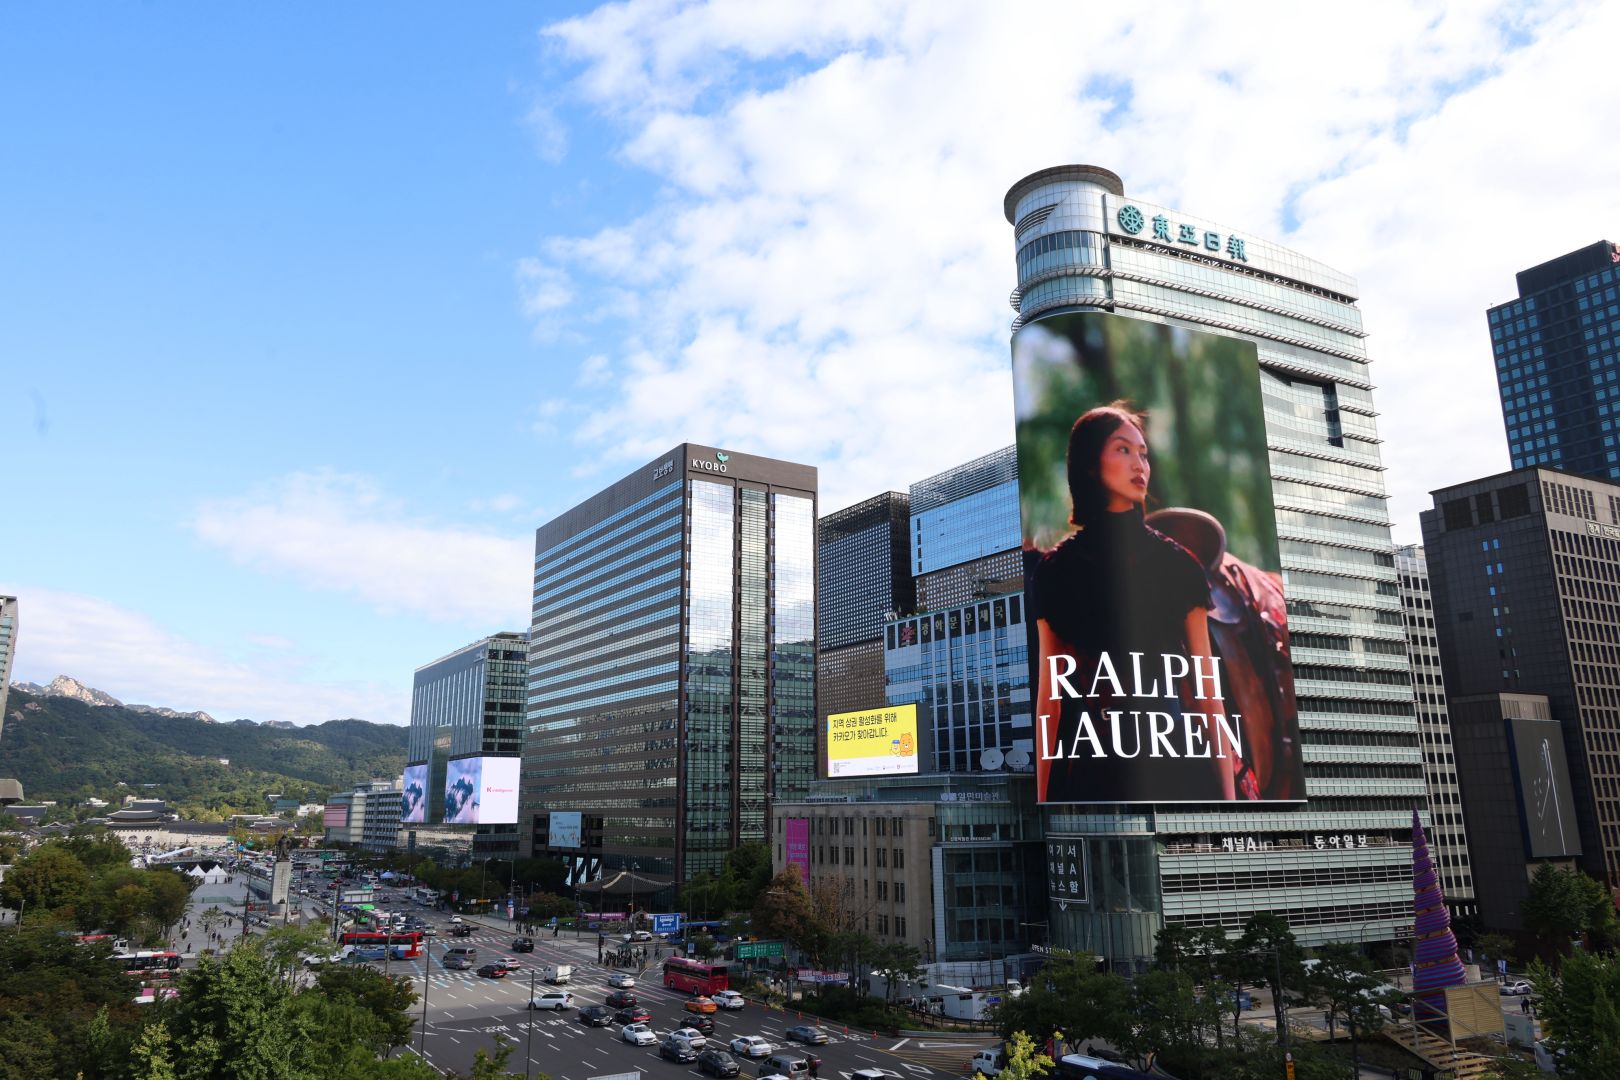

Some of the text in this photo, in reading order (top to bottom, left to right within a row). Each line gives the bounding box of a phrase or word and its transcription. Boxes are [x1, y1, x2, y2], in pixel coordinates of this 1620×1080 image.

[1151, 213, 1249, 263] 東亞日報
[692, 458, 727, 473] KYOBO
[920, 605, 1004, 637] 광화문우체국
[1046, 651, 1226, 701] RALPH
[833, 712, 897, 729] 지역 상권 활성화를 위해
[833, 730, 856, 742] 카카오가
[1039, 711, 1243, 760] LAUREN
[957, 791, 1000, 802] 일민미술관
[1222, 836, 1256, 852] 채널A
[1313, 834, 1369, 850] 동아일보
